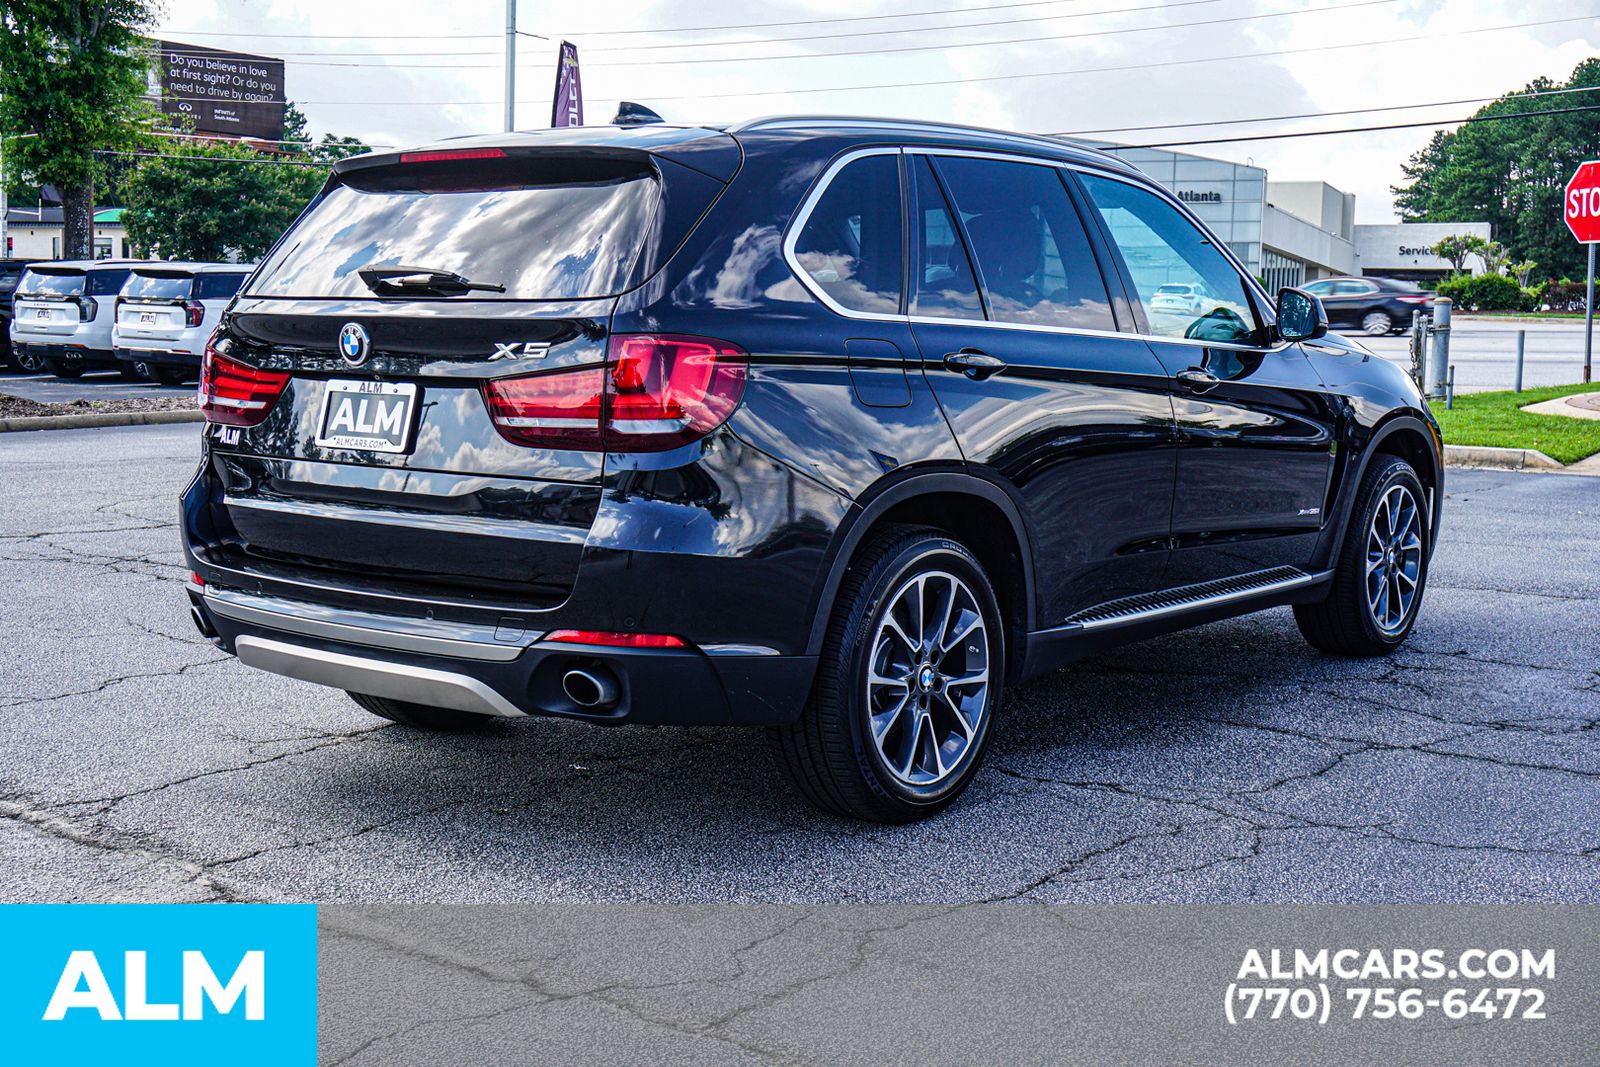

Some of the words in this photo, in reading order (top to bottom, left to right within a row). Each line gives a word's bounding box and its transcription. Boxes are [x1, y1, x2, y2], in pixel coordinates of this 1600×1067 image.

[170, 53, 185, 65] Do
[186, 58, 204, 68] you
[205, 57, 237, 73] believe
[239, 64, 247, 74] in
[249, 65, 268, 78] love
[170, 69, 180, 78] at
[182, 68, 202, 81] first
[203, 72, 231, 85] sight?
[232, 75, 245, 87] Or
[246, 78, 259, 89] do
[260, 82, 277, 92] you
[170, 82, 193, 93] need
[195, 85, 206, 94] to
[207, 86, 230, 98] drive
[232, 89, 243, 101] by
[244, 93, 274, 104] again?
[1177, 190, 1221, 202] Atlanta
[487, 342, 552, 360] X5
[359, 382, 382, 393] ALM
[329, 397, 404, 436] ALM
[335, 437, 385, 449] ALMCARS.COM
